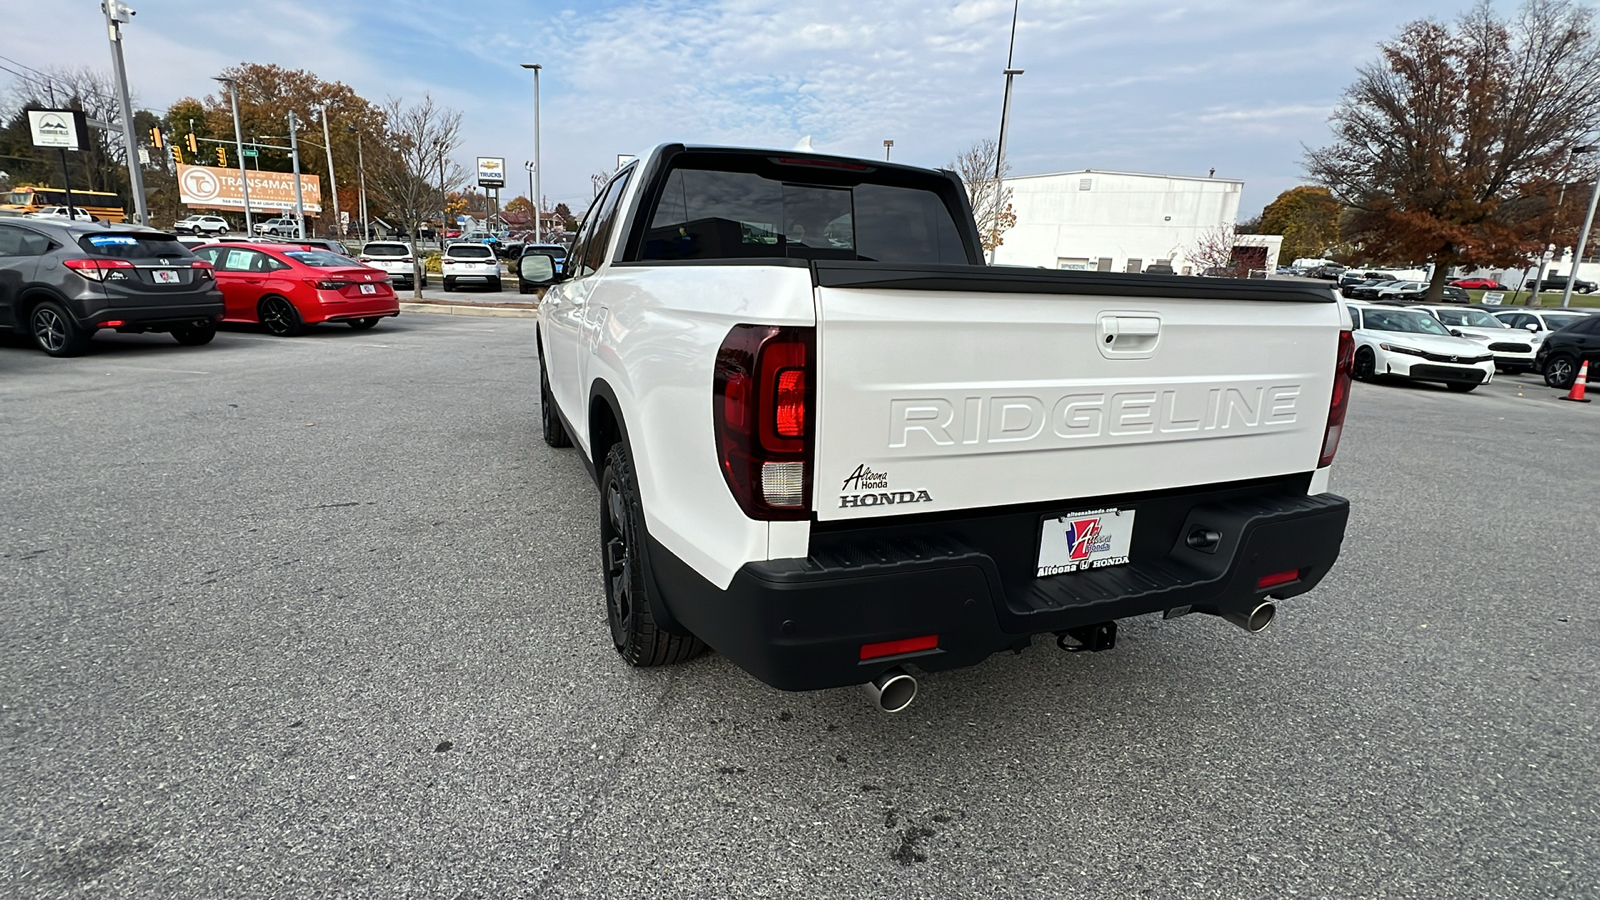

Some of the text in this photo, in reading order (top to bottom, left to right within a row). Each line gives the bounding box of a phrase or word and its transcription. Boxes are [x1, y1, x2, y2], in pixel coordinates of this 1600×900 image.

[219, 176, 317, 192] TRANS4MATON
[888, 385, 1301, 449] RIDGELINE
[842, 463, 888, 491] Altoona
[861, 481, 888, 489] Honda
[839, 490, 933, 508] HONDA
[1086, 543, 1111, 552] Honda
[1037, 556, 1130, 577] Altoona HONDA
